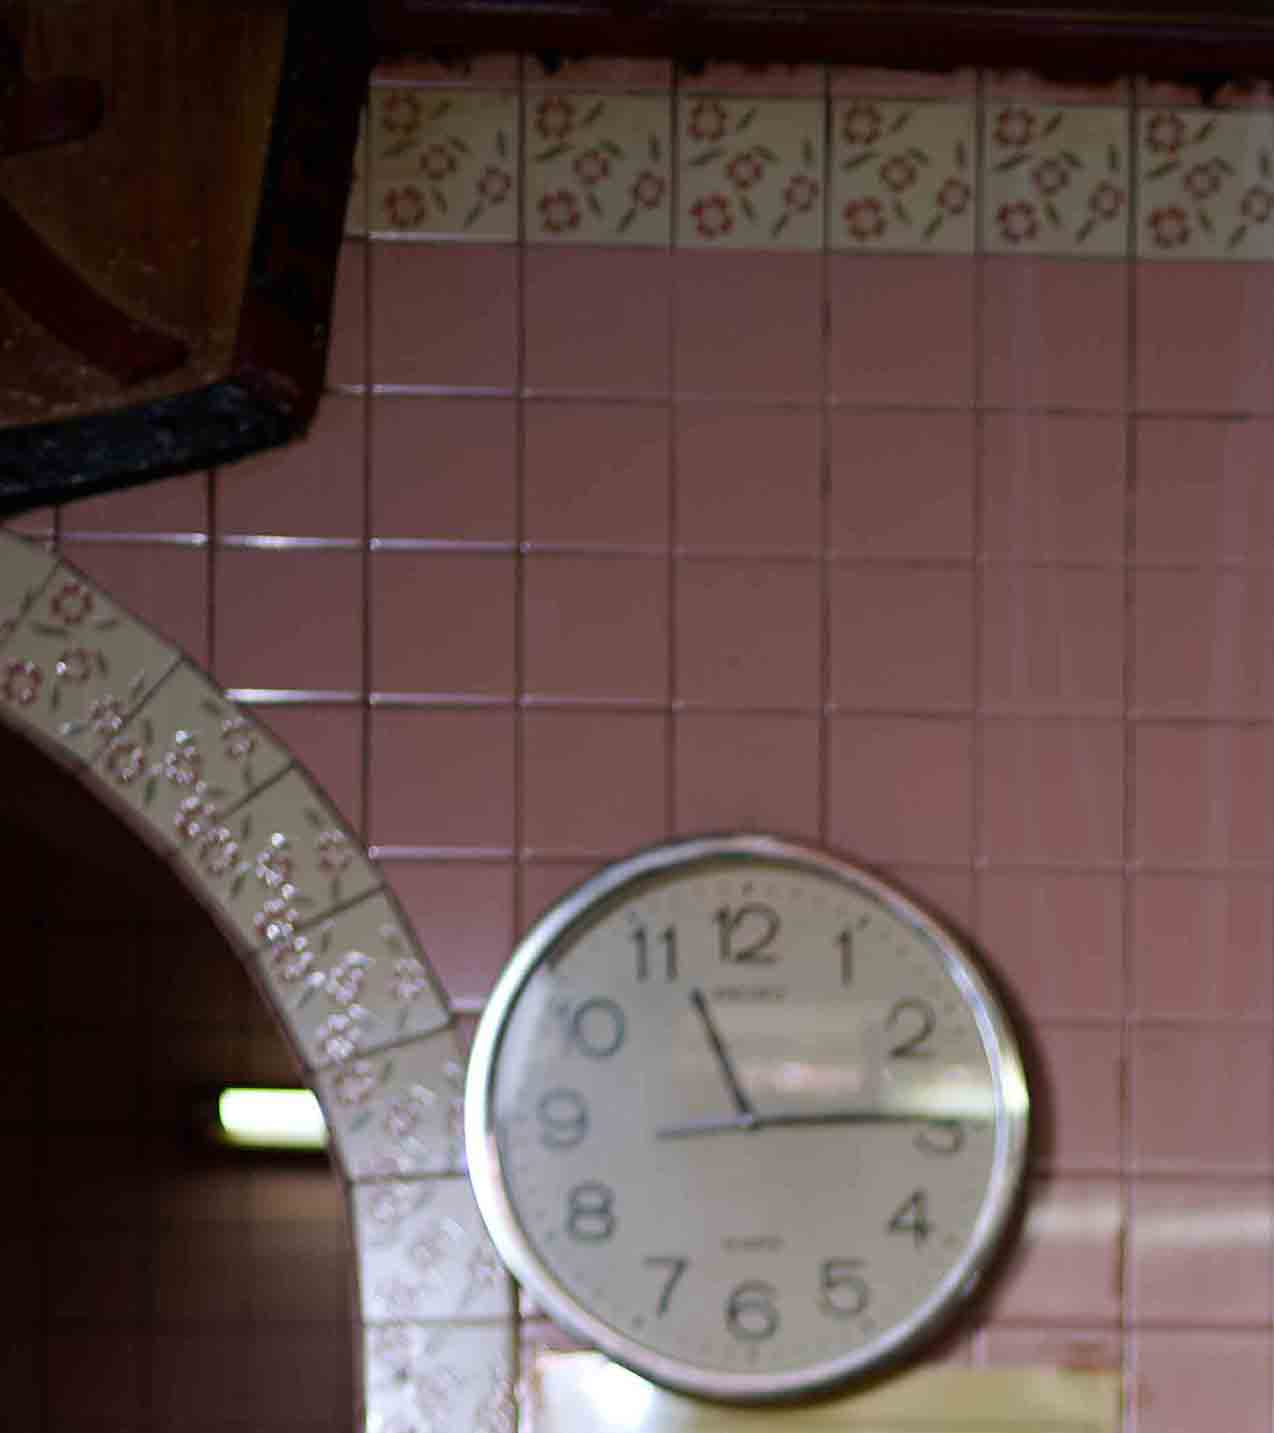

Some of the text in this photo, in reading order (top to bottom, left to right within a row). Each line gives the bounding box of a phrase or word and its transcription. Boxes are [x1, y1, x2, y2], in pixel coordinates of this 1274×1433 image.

[631, 925, 678, 984] 11
[711, 904, 781, 965] 12
[836, 928, 854, 986] 1
[886, 998, 936, 1060] 2
[538, 1089, 589, 1149] 9
[568, 1183, 616, 1243] 8
[887, 1191, 933, 1246] 4
[643, 1255, 689, 1318] 7
[724, 1281, 778, 1342] 6
[820, 1259, 870, 1318] 5
